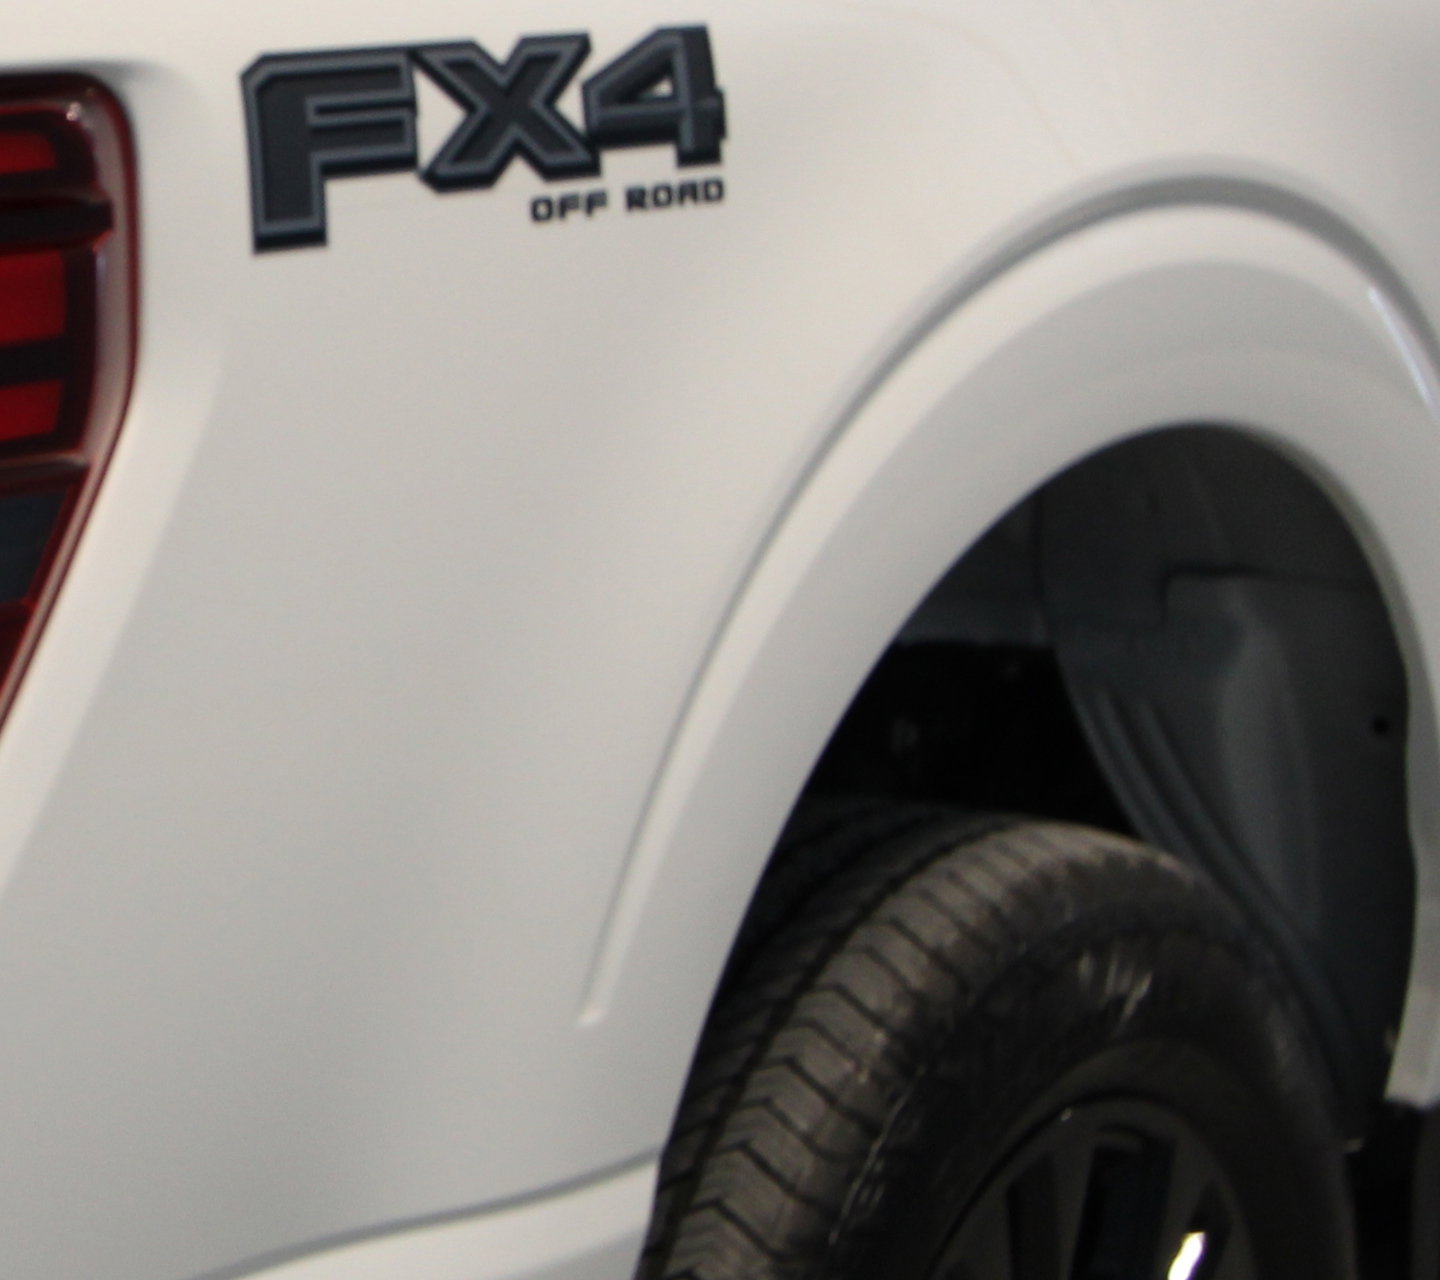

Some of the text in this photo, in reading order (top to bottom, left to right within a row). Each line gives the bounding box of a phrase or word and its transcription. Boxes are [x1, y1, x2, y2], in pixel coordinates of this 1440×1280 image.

[239, 23, 726, 253] FX4
[531, 177, 725, 223] OFF ROAD
